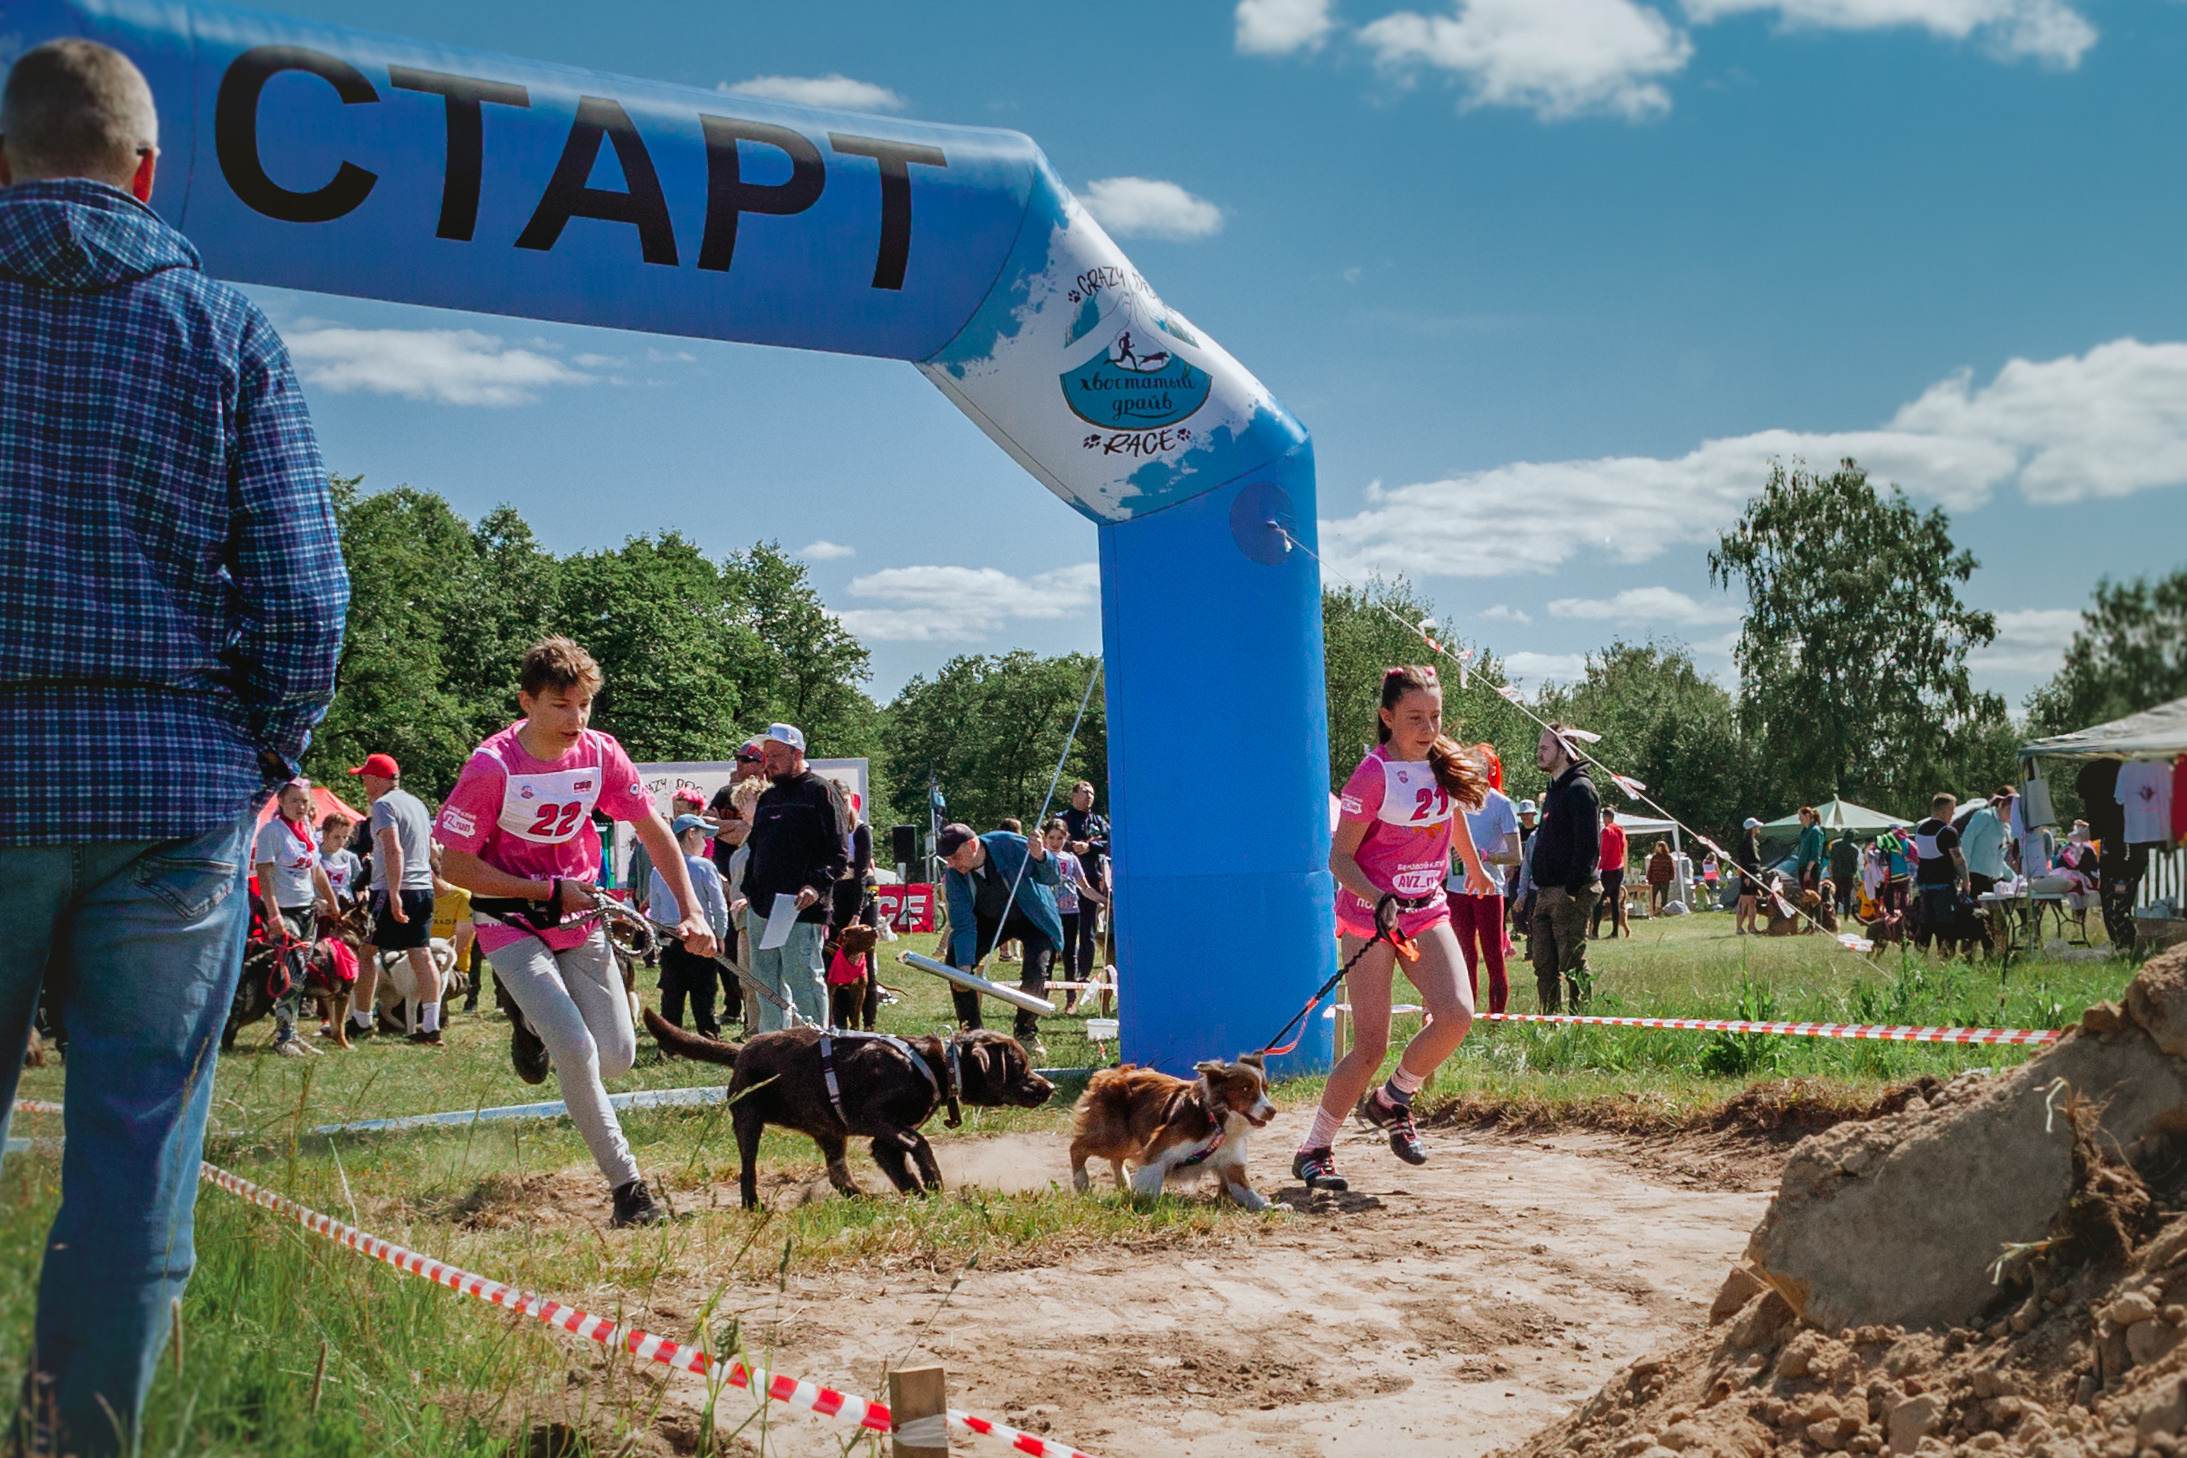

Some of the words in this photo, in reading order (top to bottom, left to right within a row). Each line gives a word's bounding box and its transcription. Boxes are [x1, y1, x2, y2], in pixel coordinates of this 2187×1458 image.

[214, 44, 948, 291] СТАРТ
[1076, 265, 1126, 296] CRAZY
[1080, 371, 1196, 391] хвостатый
[1103, 429, 1176, 457] RACE
[527, 801, 582, 837] 22
